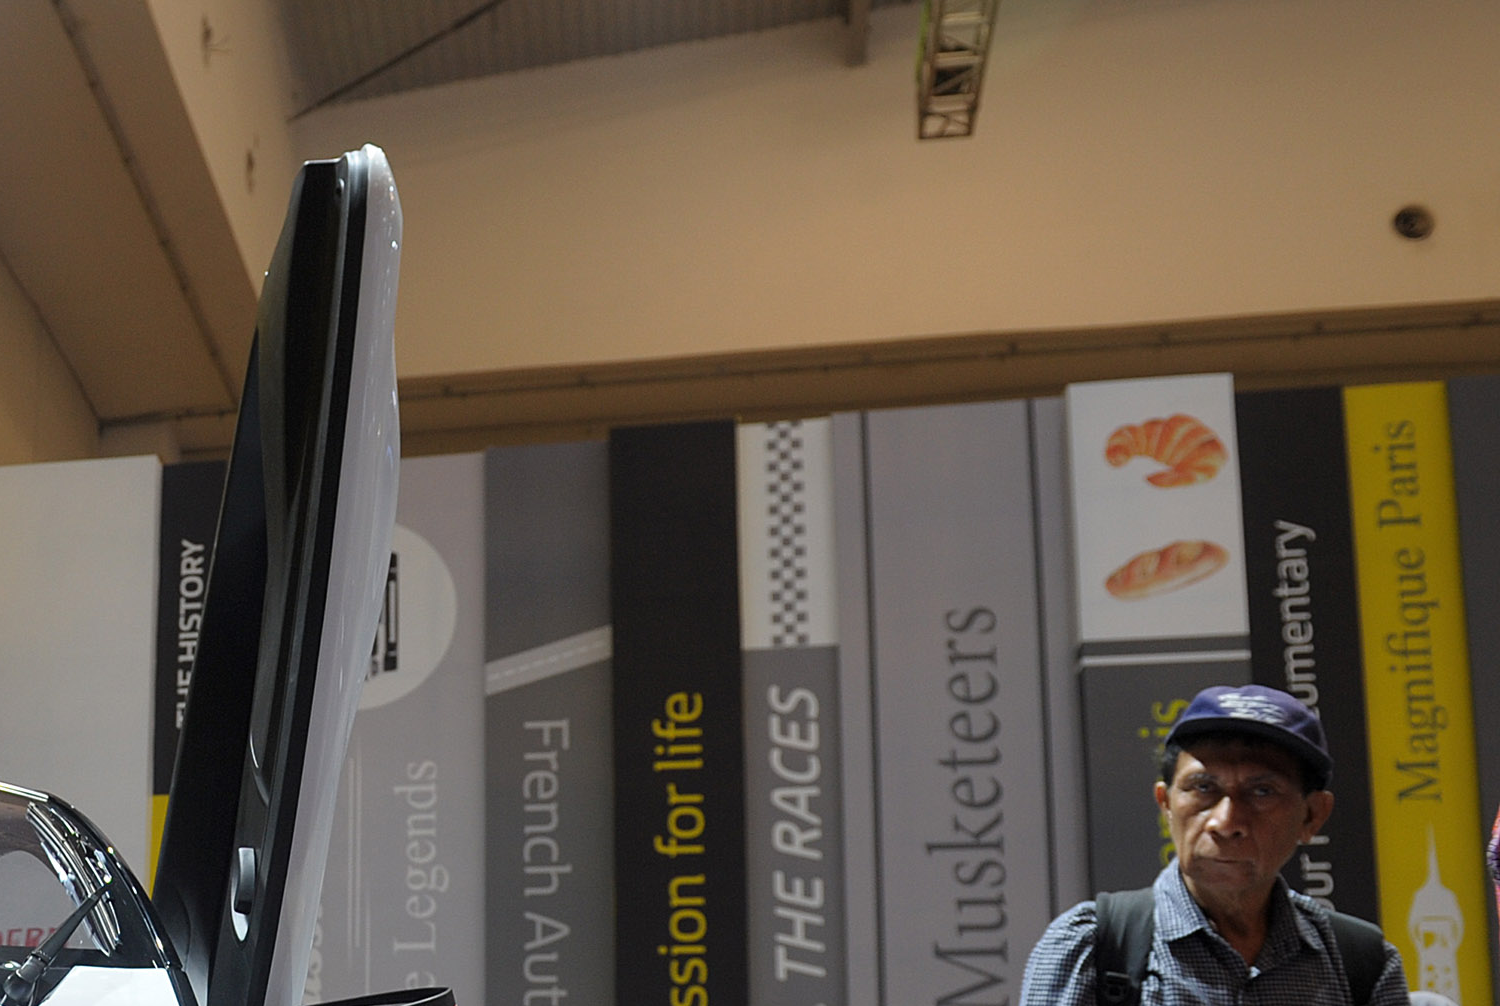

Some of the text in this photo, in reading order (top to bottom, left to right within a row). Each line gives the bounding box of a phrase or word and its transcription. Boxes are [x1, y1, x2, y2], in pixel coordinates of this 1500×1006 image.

[176, 539, 205, 664] HISTORY
[1373, 419, 1448, 804] Magnifique Paris
[651, 691, 704, 772] life
[767, 684, 822, 860] RACES
[393, 760, 450, 953] Legends
[522, 718, 573, 897] French
[653, 783, 706, 858] for
[773, 870, 827, 981] THE
